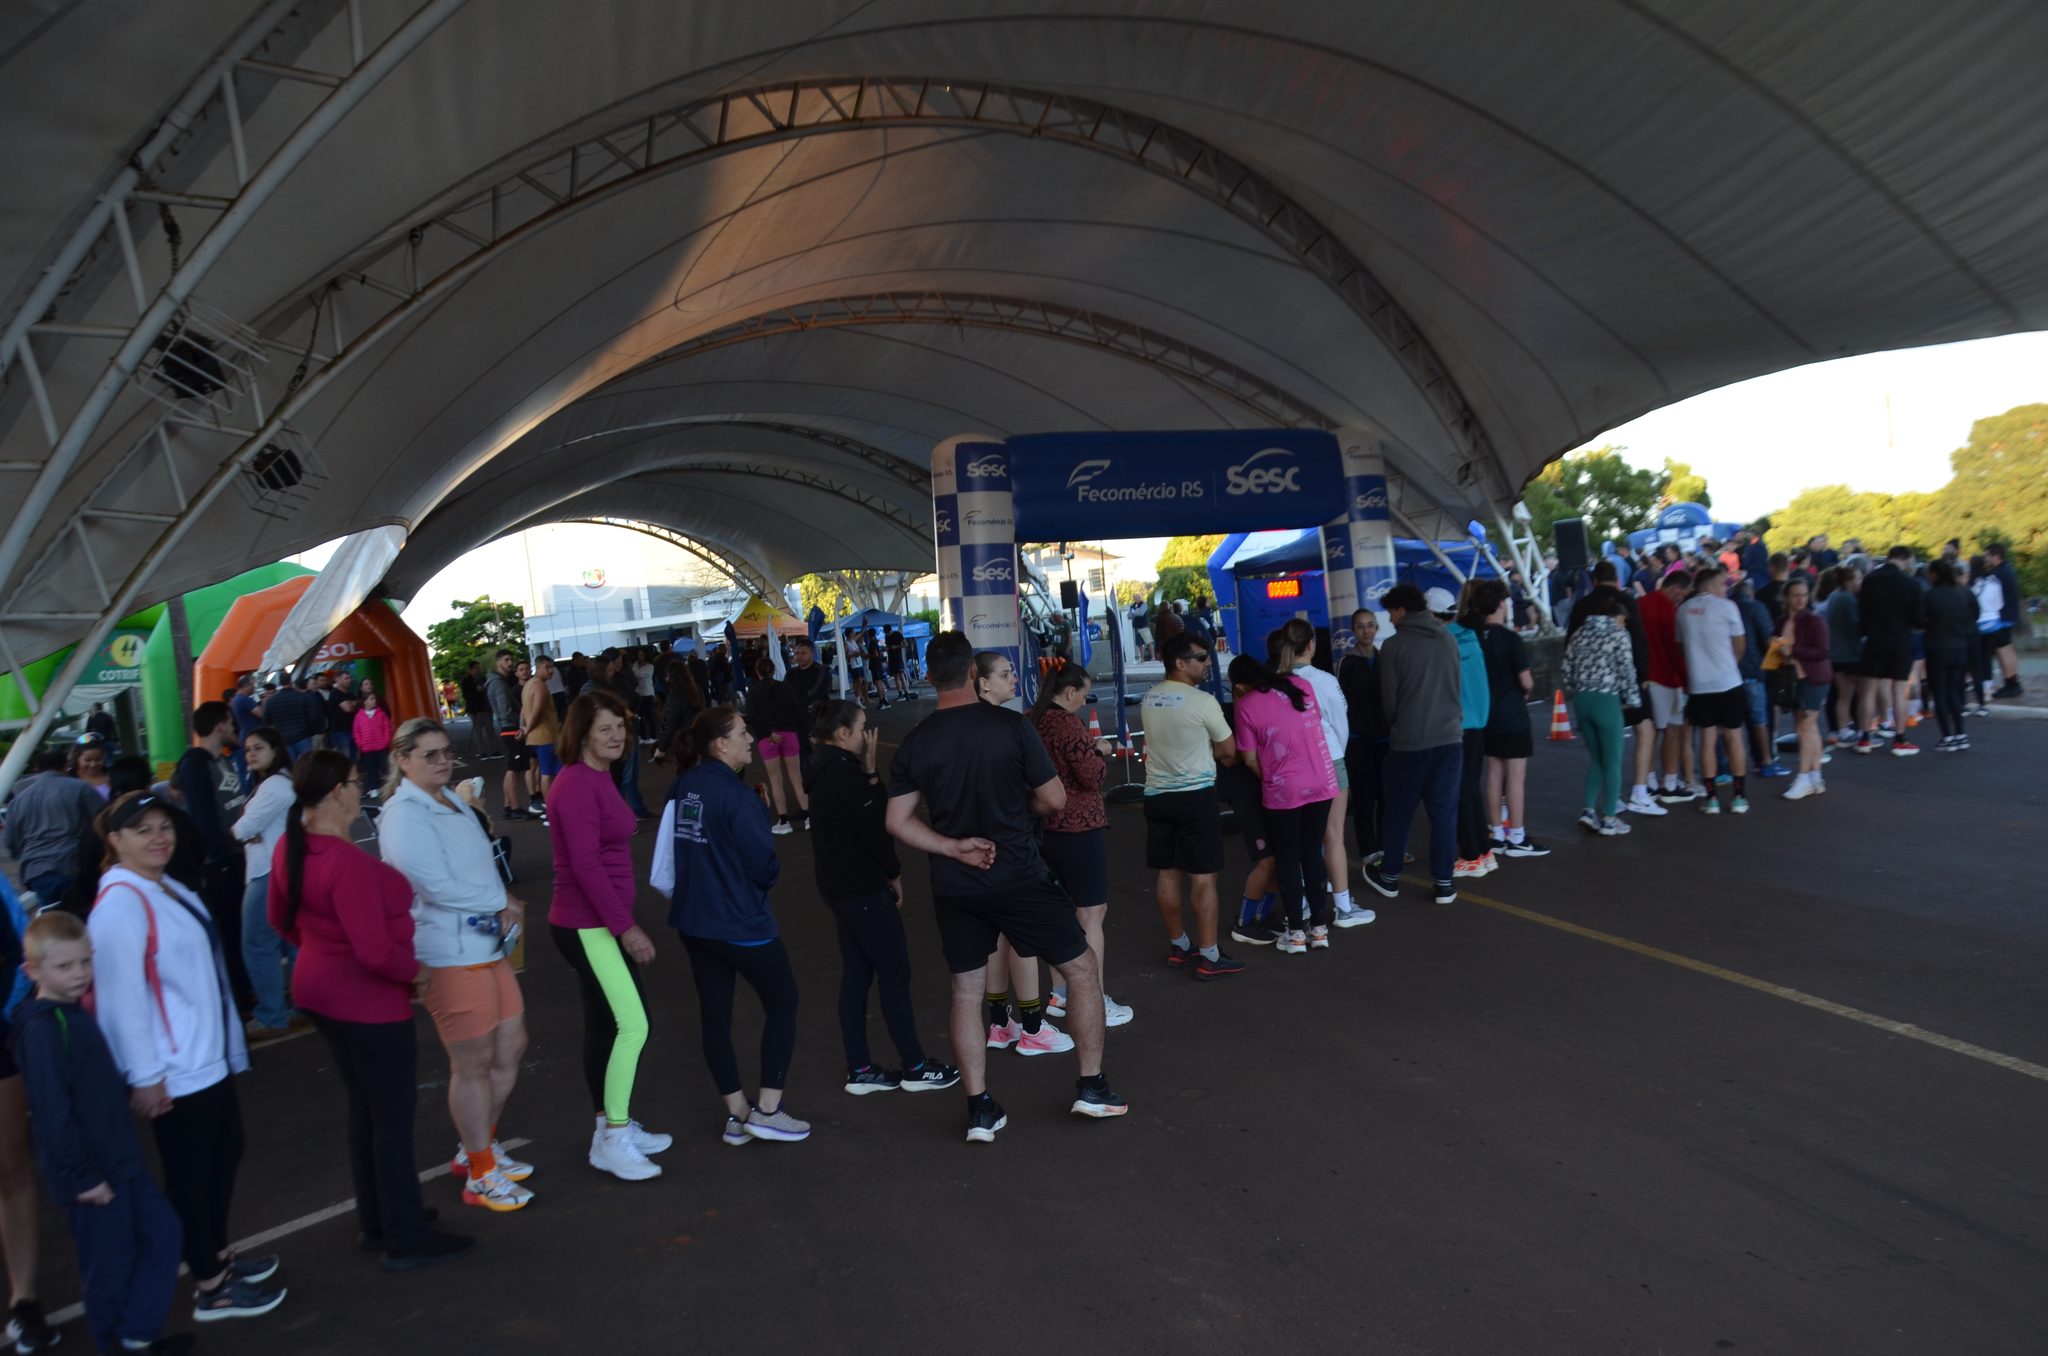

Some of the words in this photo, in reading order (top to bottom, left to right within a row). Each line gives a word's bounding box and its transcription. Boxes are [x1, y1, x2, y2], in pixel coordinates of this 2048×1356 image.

[1225, 464, 1300, 495] Sesc
[1078, 482, 1176, 502] Fecomércio
[1181, 481, 1204, 498] RS
[922, 1071, 943, 1080] FILA
